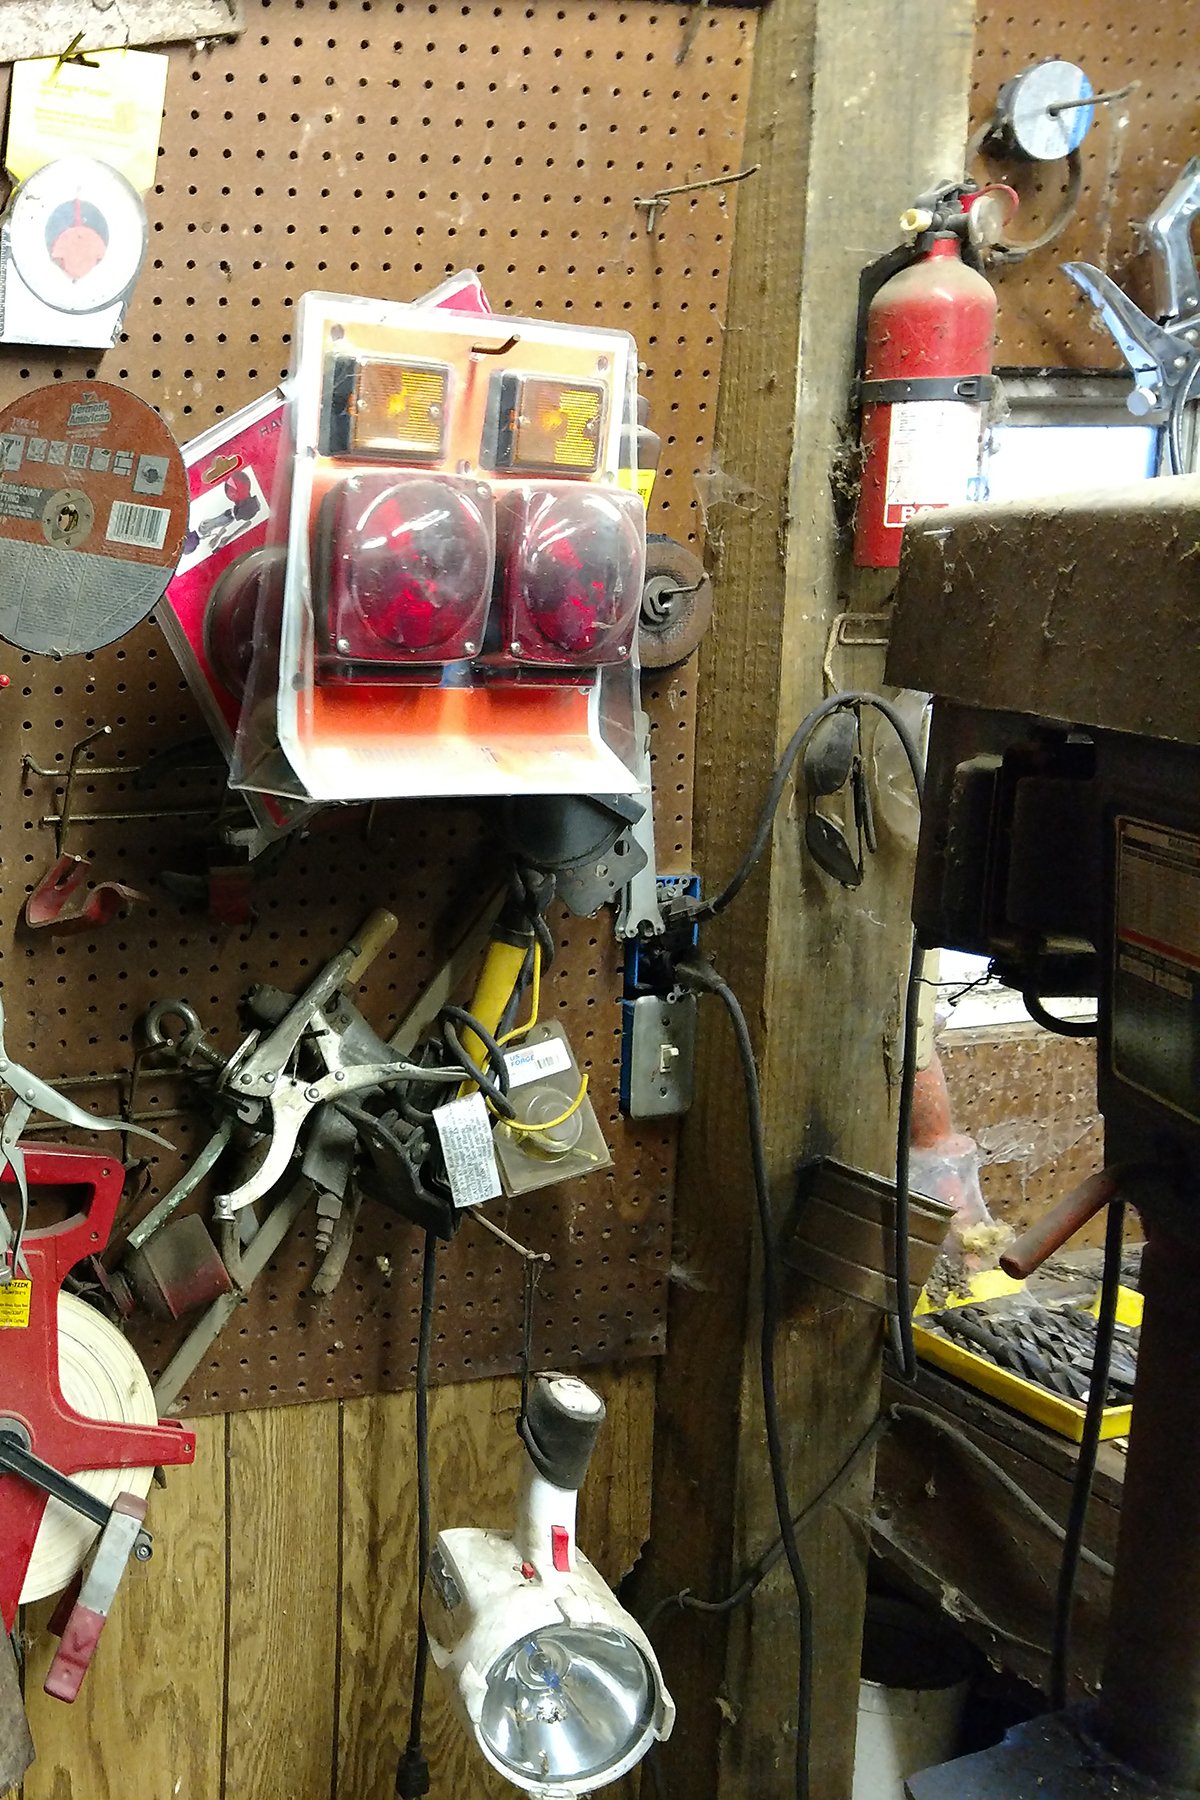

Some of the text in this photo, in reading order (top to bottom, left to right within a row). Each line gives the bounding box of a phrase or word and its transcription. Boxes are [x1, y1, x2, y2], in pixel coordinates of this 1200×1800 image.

[71, 402, 108, 414] Vermont
[69, 412, 110, 424] American
[509, 1053, 521, 1061] US
[510, 1054, 535, 1067] FORGE
